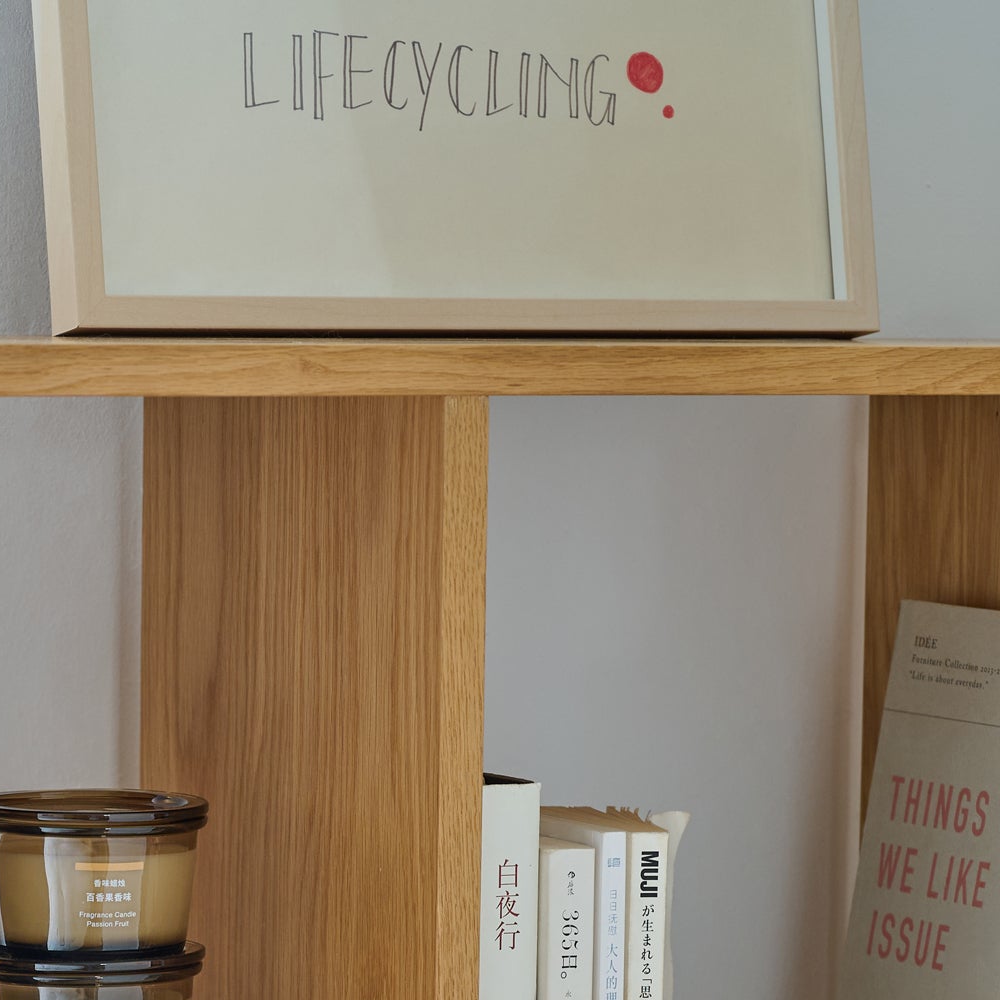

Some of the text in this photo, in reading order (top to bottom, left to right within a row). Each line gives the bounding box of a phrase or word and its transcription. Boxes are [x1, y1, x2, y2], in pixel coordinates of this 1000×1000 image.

[243, 30, 616, 131] LIFECYCLING
[935, 674, 954, 686] about
[944, 658, 979, 672] Collection
[890, 775, 990, 837] THINGS
[86, 892, 132, 902] 百香果香味
[494, 859, 521, 951] 白夜行
[877, 842, 991, 908] WE LIKE
[79, 911, 113, 919] Fragrance
[867, 910, 950, 971] ISSUE
